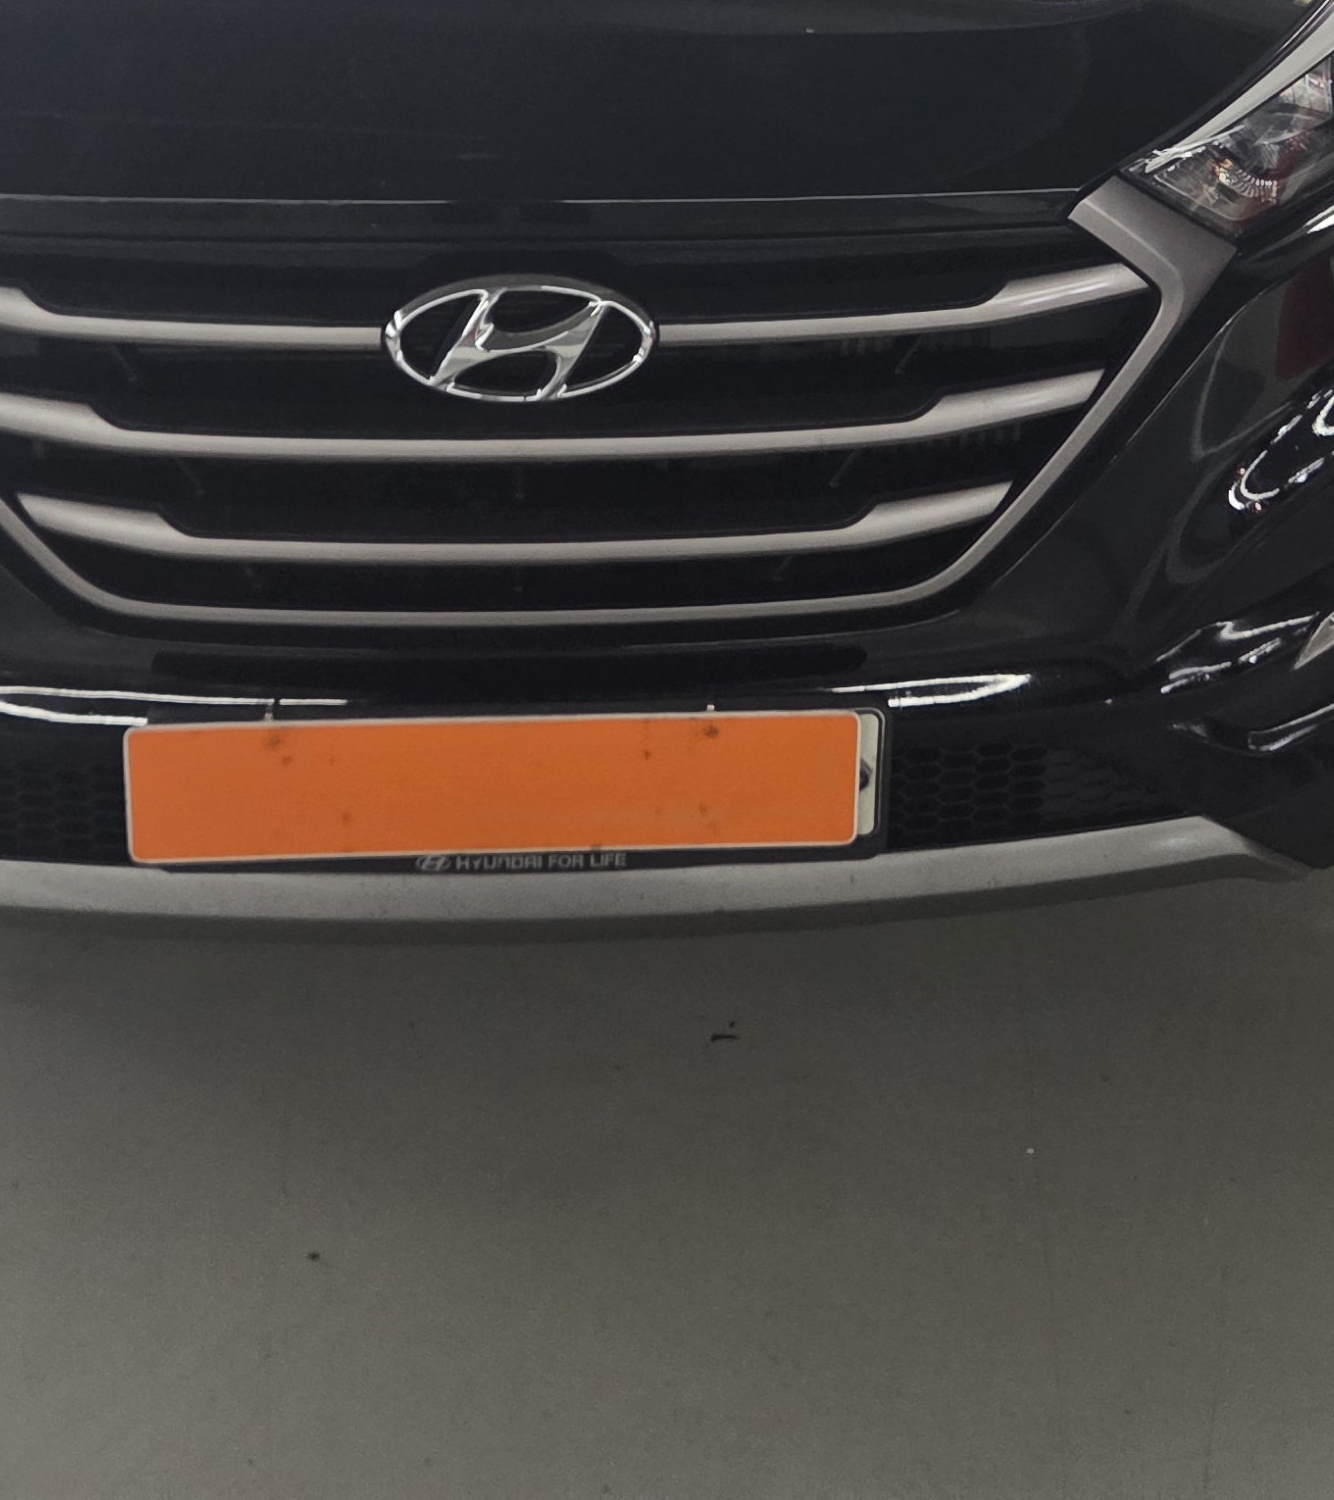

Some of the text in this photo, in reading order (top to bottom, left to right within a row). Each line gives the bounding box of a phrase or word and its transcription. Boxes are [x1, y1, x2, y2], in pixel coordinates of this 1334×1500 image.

[455, 851, 628, 871] HYUNDAI FOR LIFE
